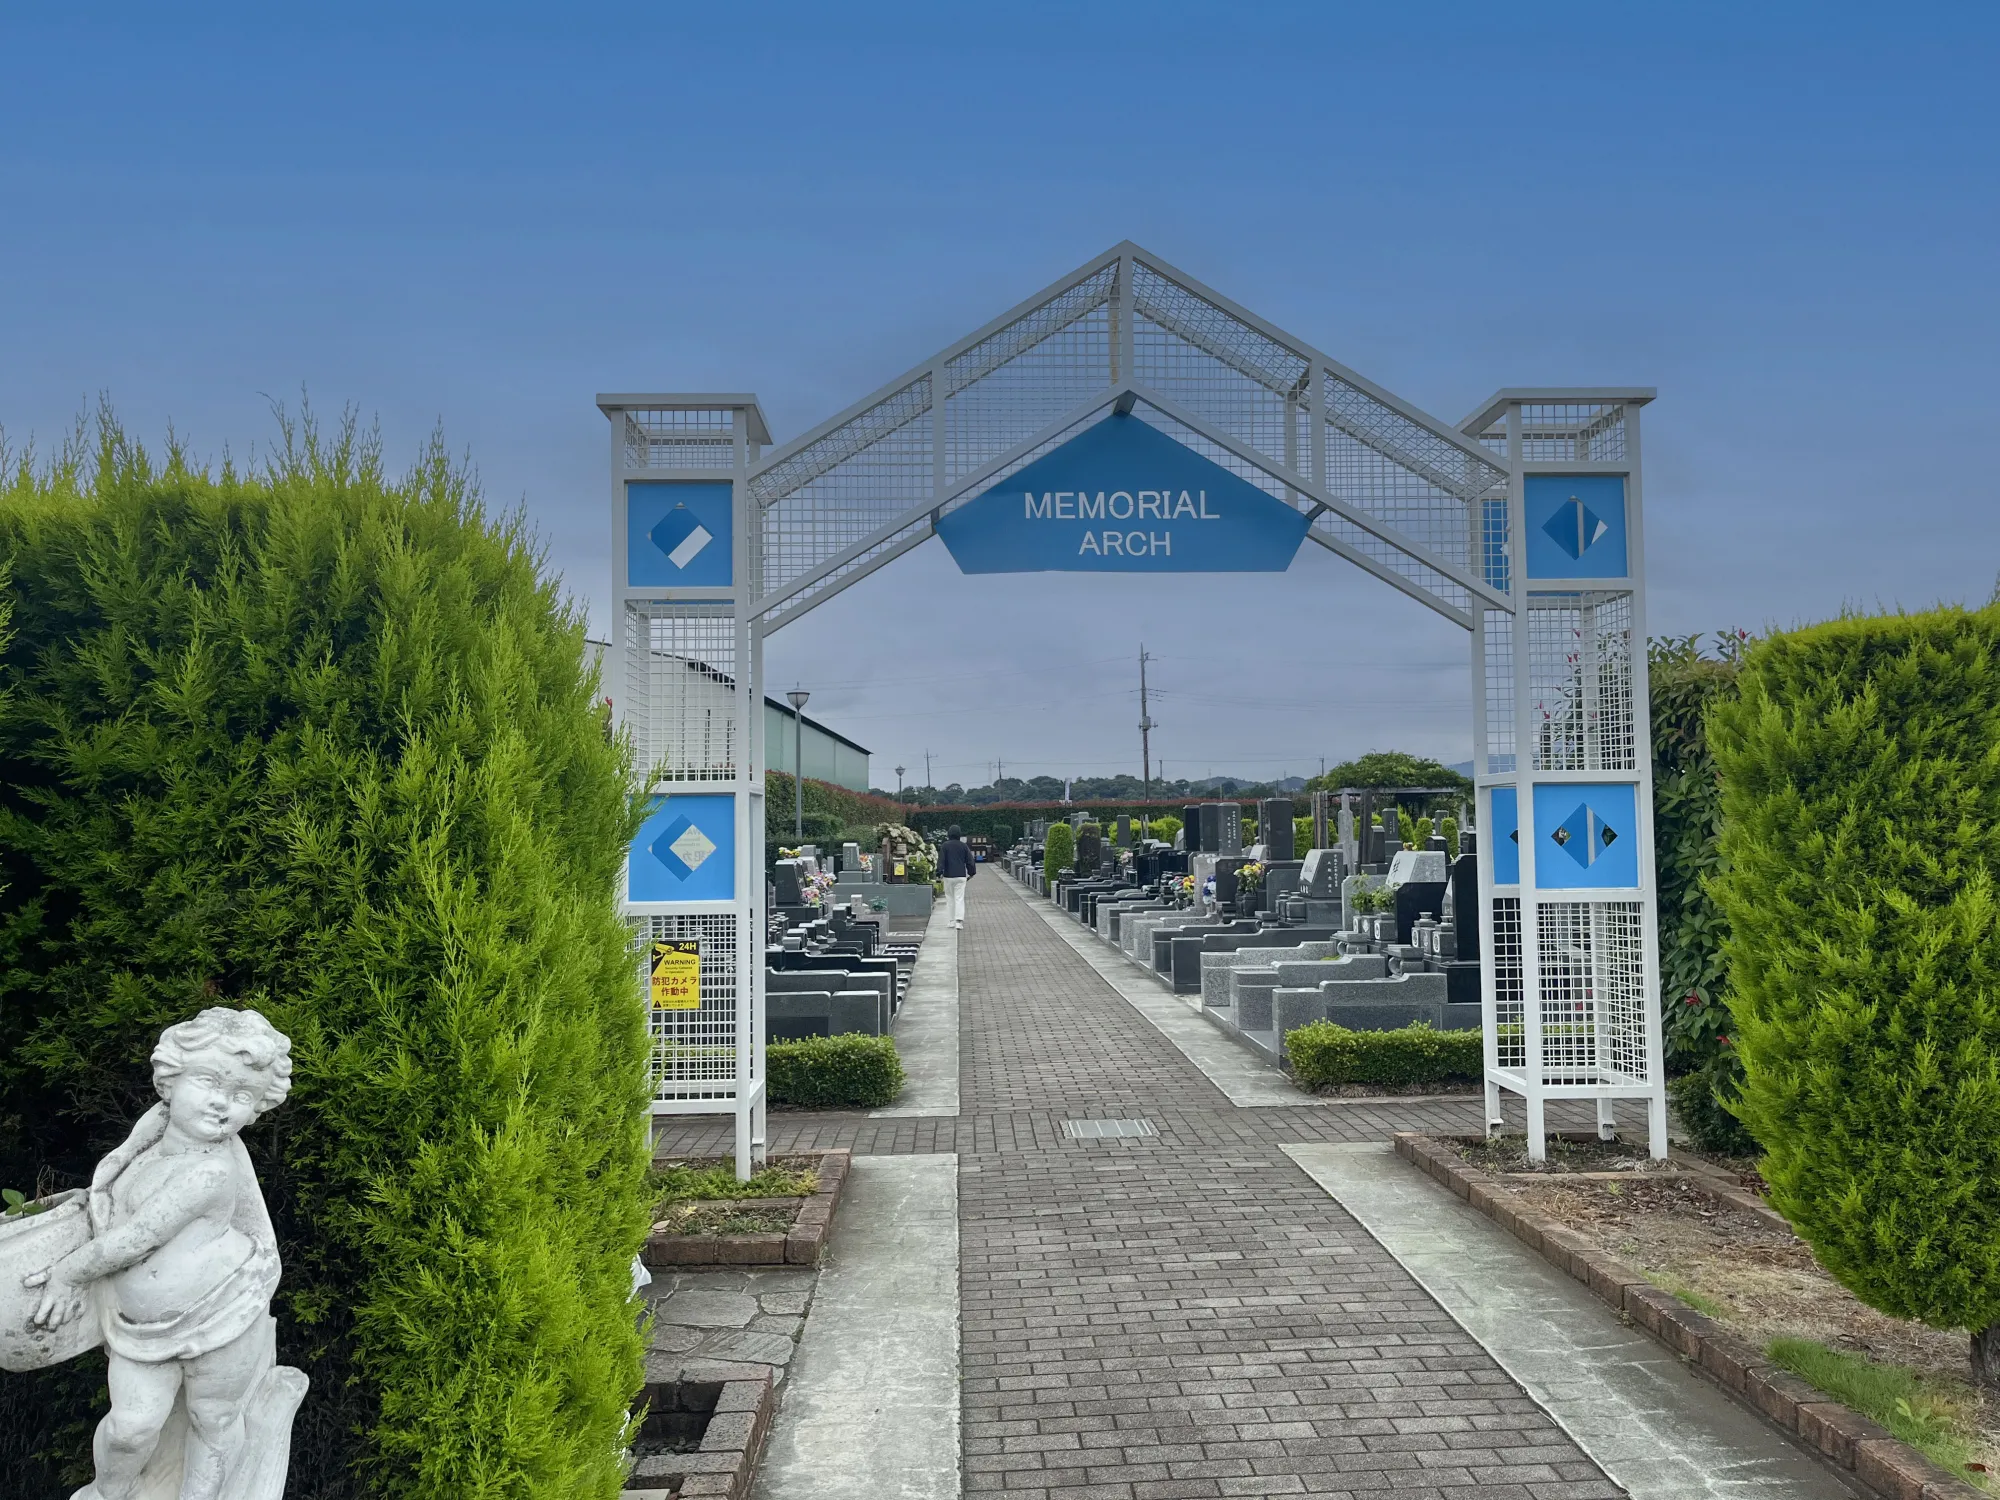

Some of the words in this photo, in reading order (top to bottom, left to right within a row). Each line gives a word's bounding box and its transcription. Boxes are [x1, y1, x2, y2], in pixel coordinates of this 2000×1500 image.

[1024, 490, 1221, 520] MEMORIAL
[1078, 530, 1171, 557] ARCH
[679, 943, 696, 951] 24H
[652, 976, 697, 986] 防犯カメラ
[661, 987, 688, 996] 作動中
